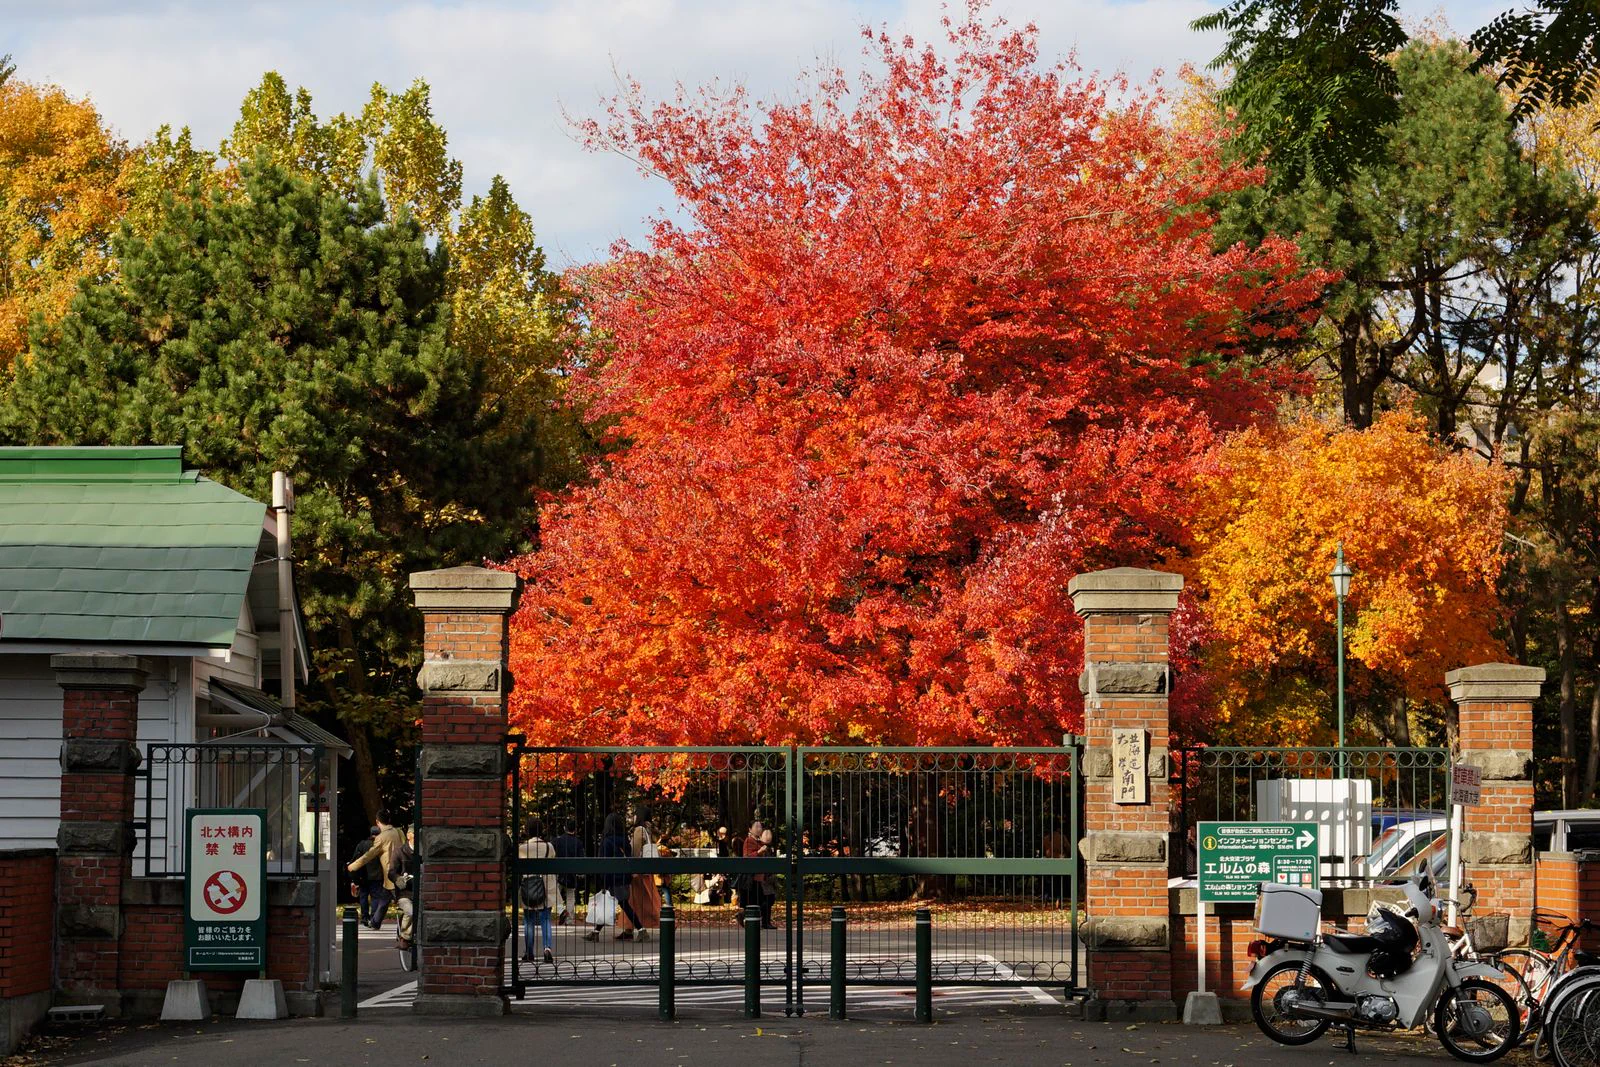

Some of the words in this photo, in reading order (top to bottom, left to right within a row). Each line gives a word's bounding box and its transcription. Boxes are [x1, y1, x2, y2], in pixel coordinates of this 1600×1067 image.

[1121, 769, 1136, 799] 南門
[200, 825, 253, 838] 北大構内
[1204, 862, 1270, 874] エルムの森
[197, 926, 252, 934] 皆様のご協力を
